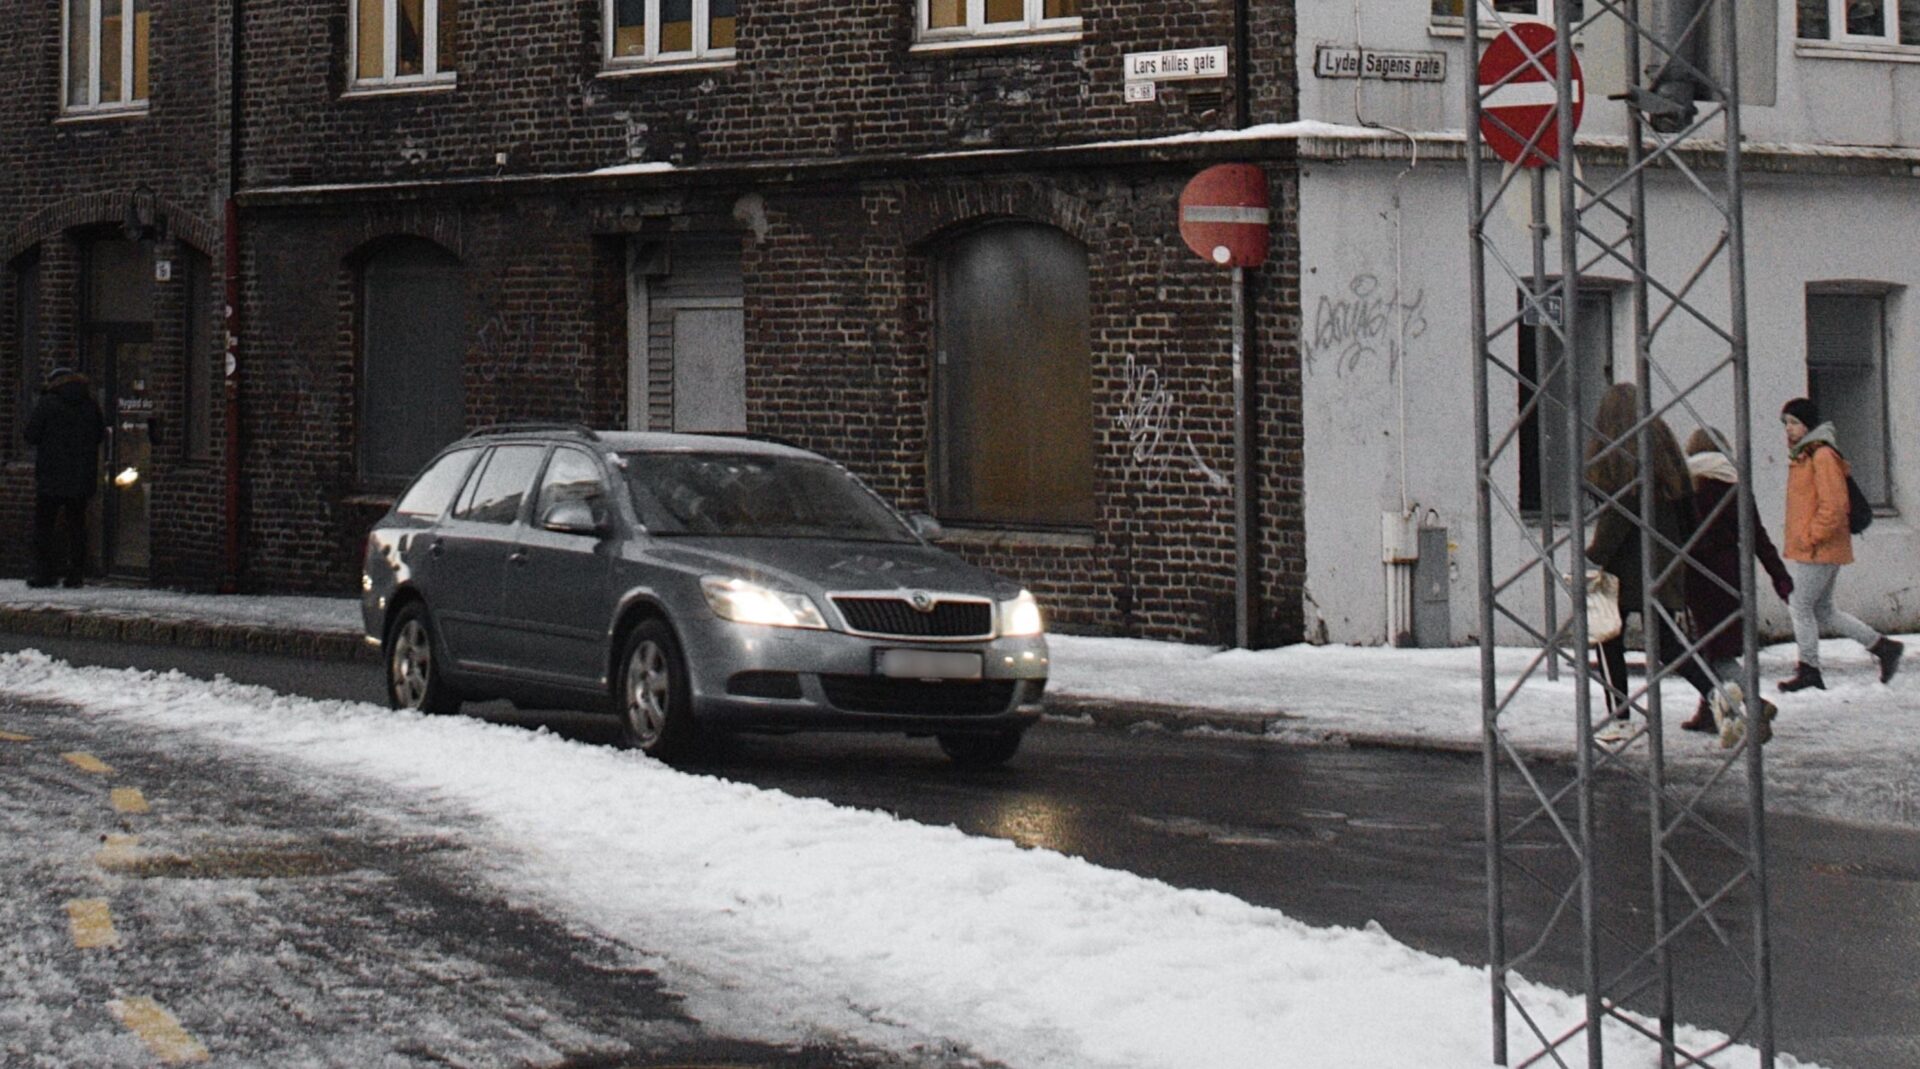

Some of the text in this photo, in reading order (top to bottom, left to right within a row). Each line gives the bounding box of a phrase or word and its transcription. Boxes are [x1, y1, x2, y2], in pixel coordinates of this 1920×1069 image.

[1133, 53, 1215, 75] Lars Hilles gate
[1365, 53, 1411, 77] Sagens
[1414, 57, 1440, 78] gate
